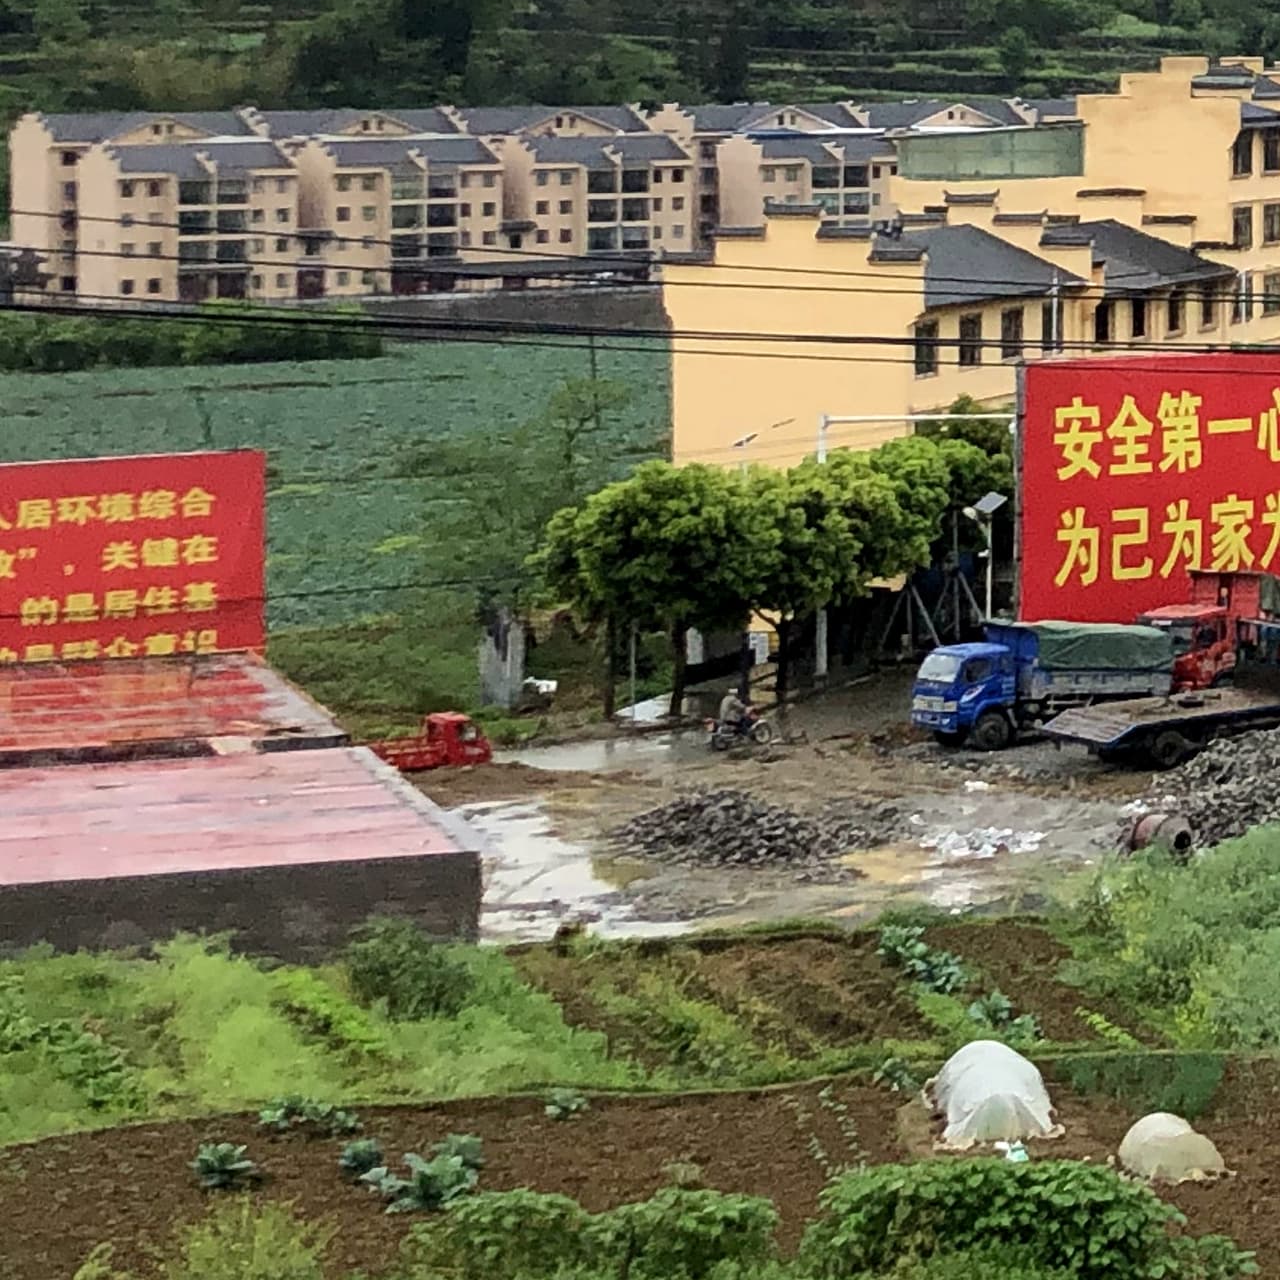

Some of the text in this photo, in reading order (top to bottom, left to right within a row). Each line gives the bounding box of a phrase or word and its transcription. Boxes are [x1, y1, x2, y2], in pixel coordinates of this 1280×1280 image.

[0, 629, 217, 662] 是群众意识
